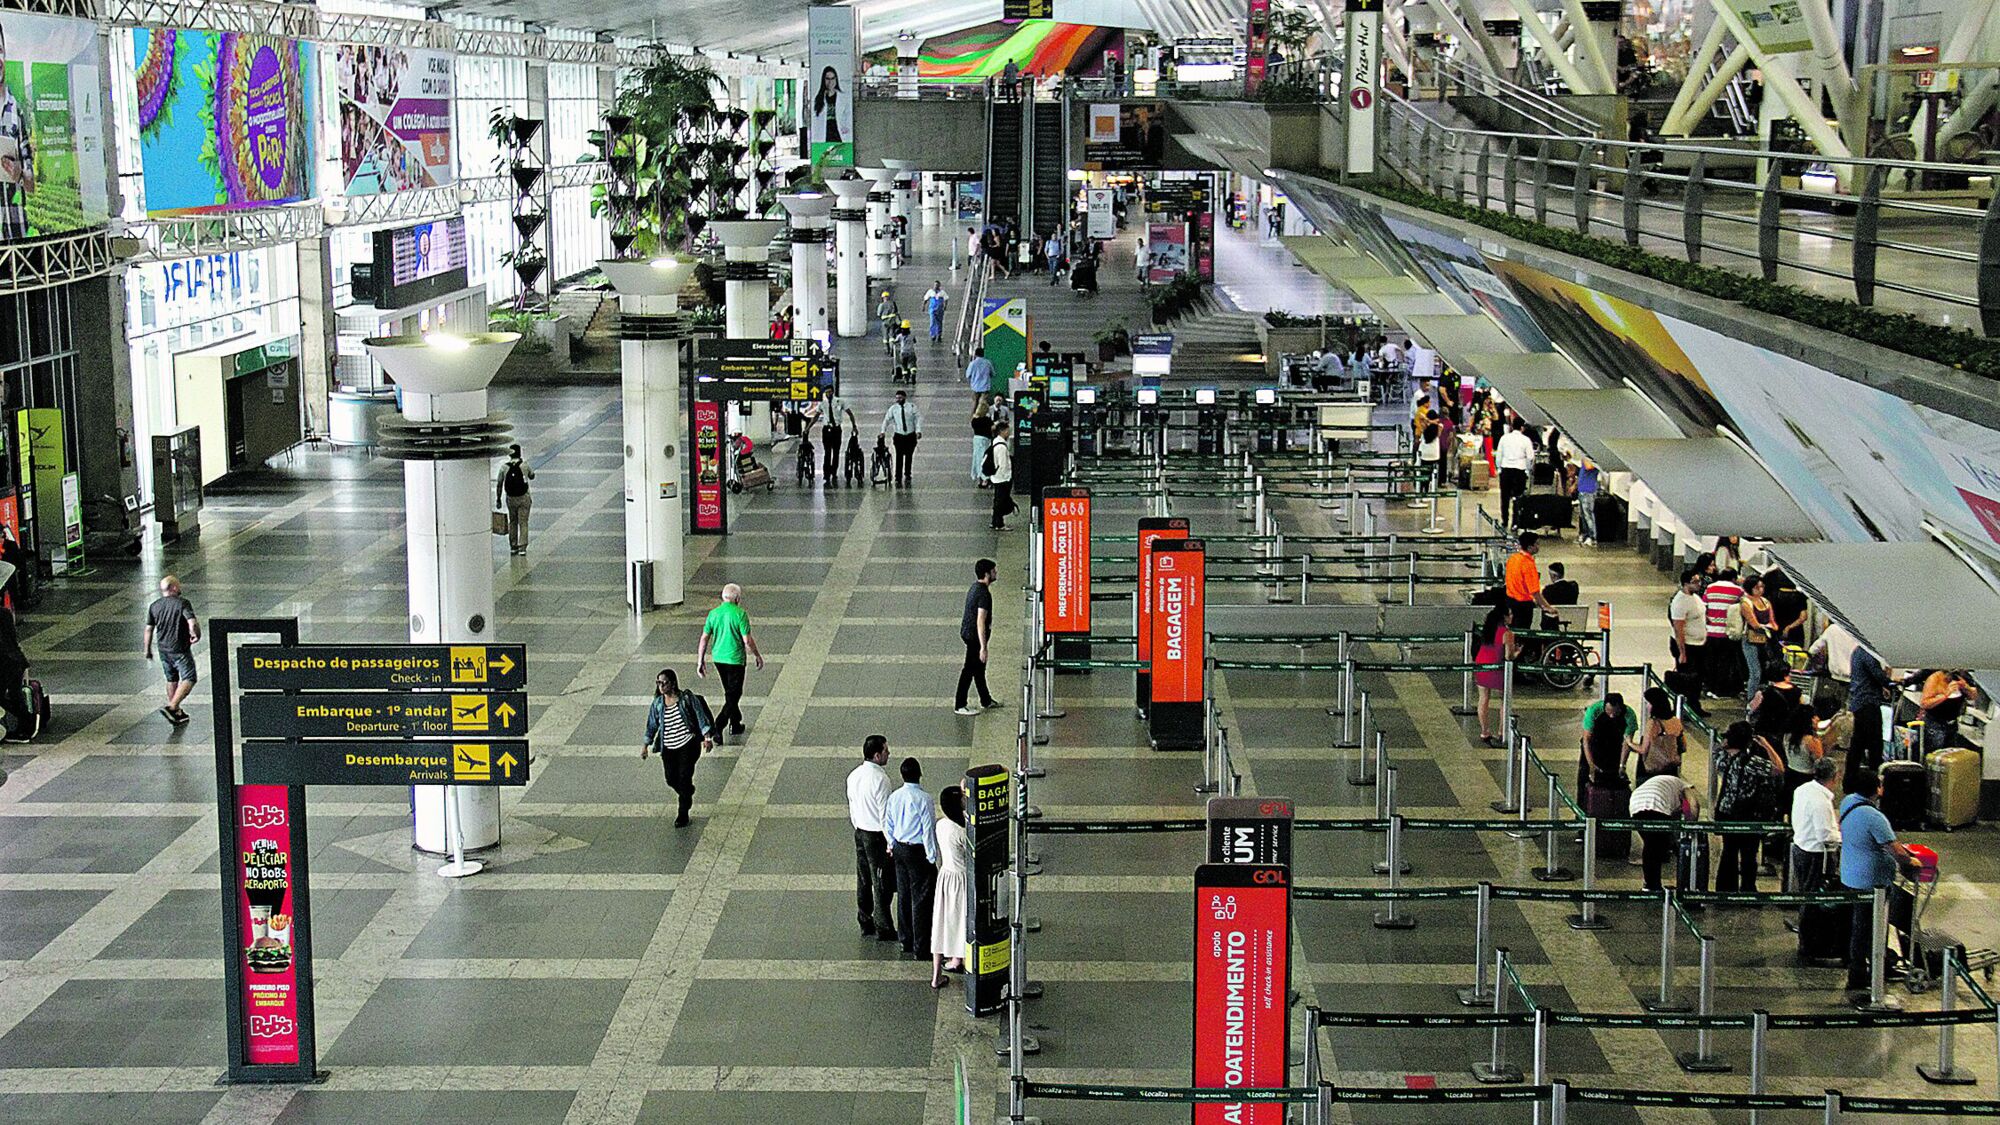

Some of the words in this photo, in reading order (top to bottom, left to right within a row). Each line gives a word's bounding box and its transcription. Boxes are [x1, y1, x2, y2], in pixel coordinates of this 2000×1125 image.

[1358, 22, 1368, 46] Hut
[1355, 49, 1368, 84] Pizza
[1020, 420, 1031, 428] Az
[1184, 541, 1203, 549] GOL
[1167, 578, 1182, 660] BAGAGEM
[254, 658, 326, 670] Despacho
[330, 657, 348, 669] de
[352, 658, 439, 670] passageiros
[391, 673, 422, 683] Check
[430, 673, 441, 683] in
[297, 706, 372, 719] Embarque
[386, 706, 400, 717] 1º
[405, 706, 447, 717] andar
[347, 722, 399, 731] Departure
[423, 721, 447, 730] floor
[346, 754, 447, 768] Desembarque
[409, 770, 448, 780] Arrivals
[978, 786, 1009, 799] BAGA
[979, 800, 994, 811] DE
[1259, 801, 1291, 816] GOL
[242, 805, 285, 828] Bob's
[251, 839, 278, 850] VENHA
[1222, 826, 1231, 854] cliente
[1234, 827, 1255, 863] UM
[243, 852, 287, 867] DELICIAR
[246, 868, 259, 879] NO
[1253, 870, 1286, 884] GOL
[244, 879, 288, 890] AEROPORTO
[250, 1015, 292, 1038] Bob's
[1225, 931, 1246, 1124] AUOATENDIMENTO
